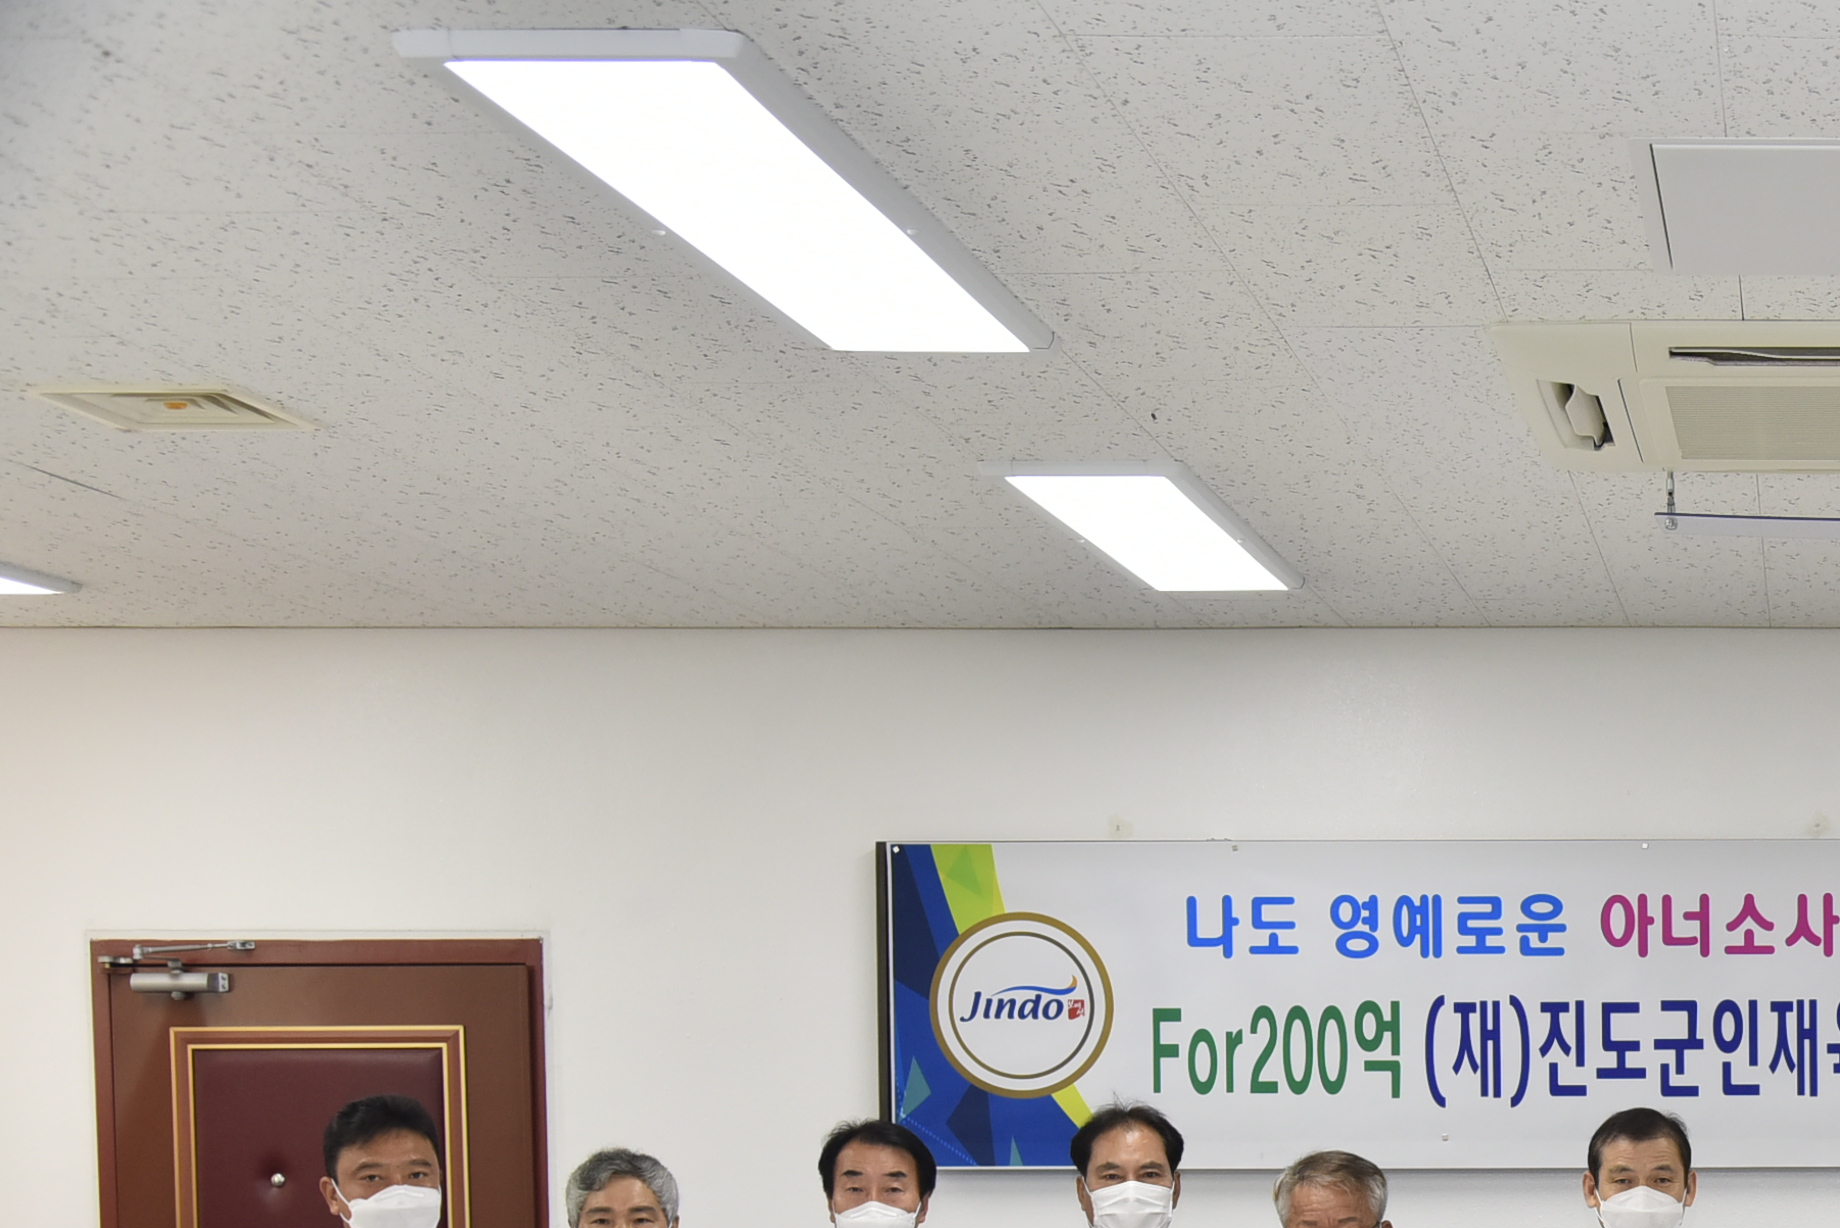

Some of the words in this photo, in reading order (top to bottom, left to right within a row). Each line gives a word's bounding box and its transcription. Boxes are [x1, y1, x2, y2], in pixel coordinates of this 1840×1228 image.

[1185, 893, 1299, 958] 나도
[1329, 893, 1568, 959] 영예로운
[959, 991, 1064, 1022] Jindo
[1151, 1000, 1402, 1099] For200억
